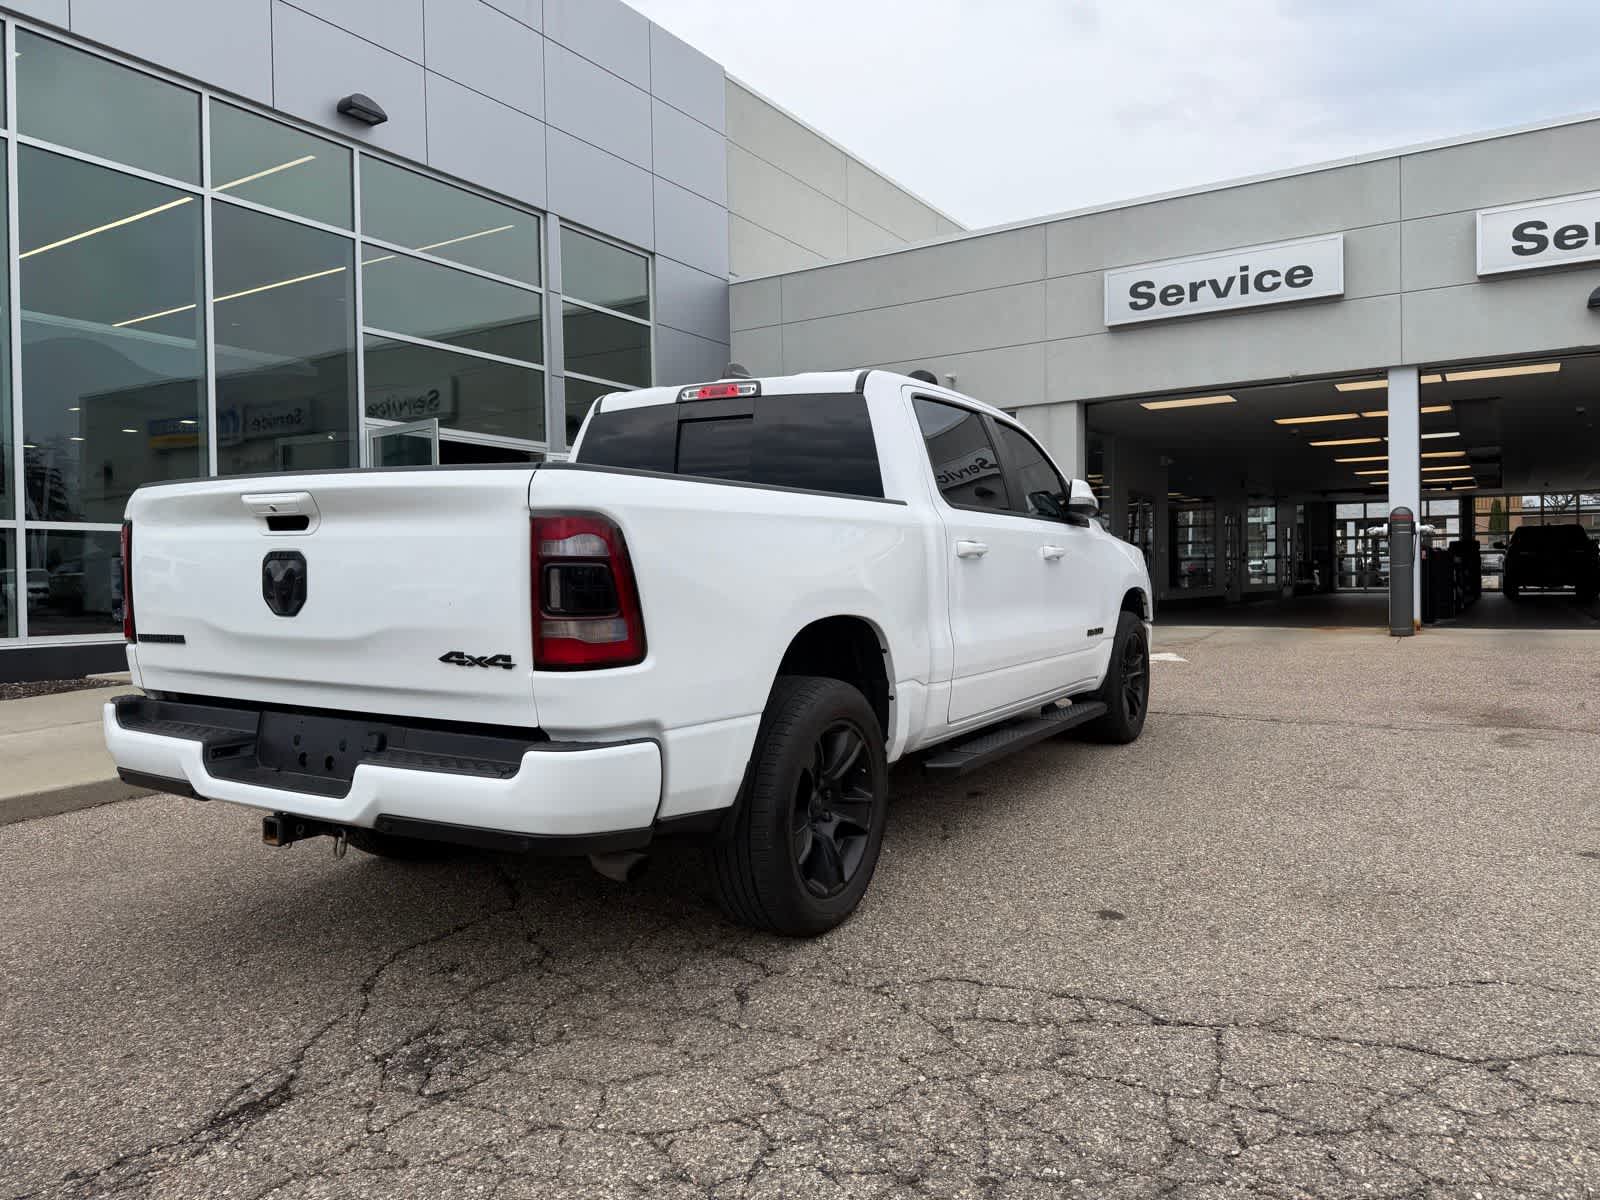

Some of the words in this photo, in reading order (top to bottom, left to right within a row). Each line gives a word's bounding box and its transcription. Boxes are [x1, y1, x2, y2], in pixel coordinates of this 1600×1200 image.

[1511, 220, 1600, 256] Se
[1128, 264, 1314, 311] Service
[438, 651, 516, 669] 4x4
